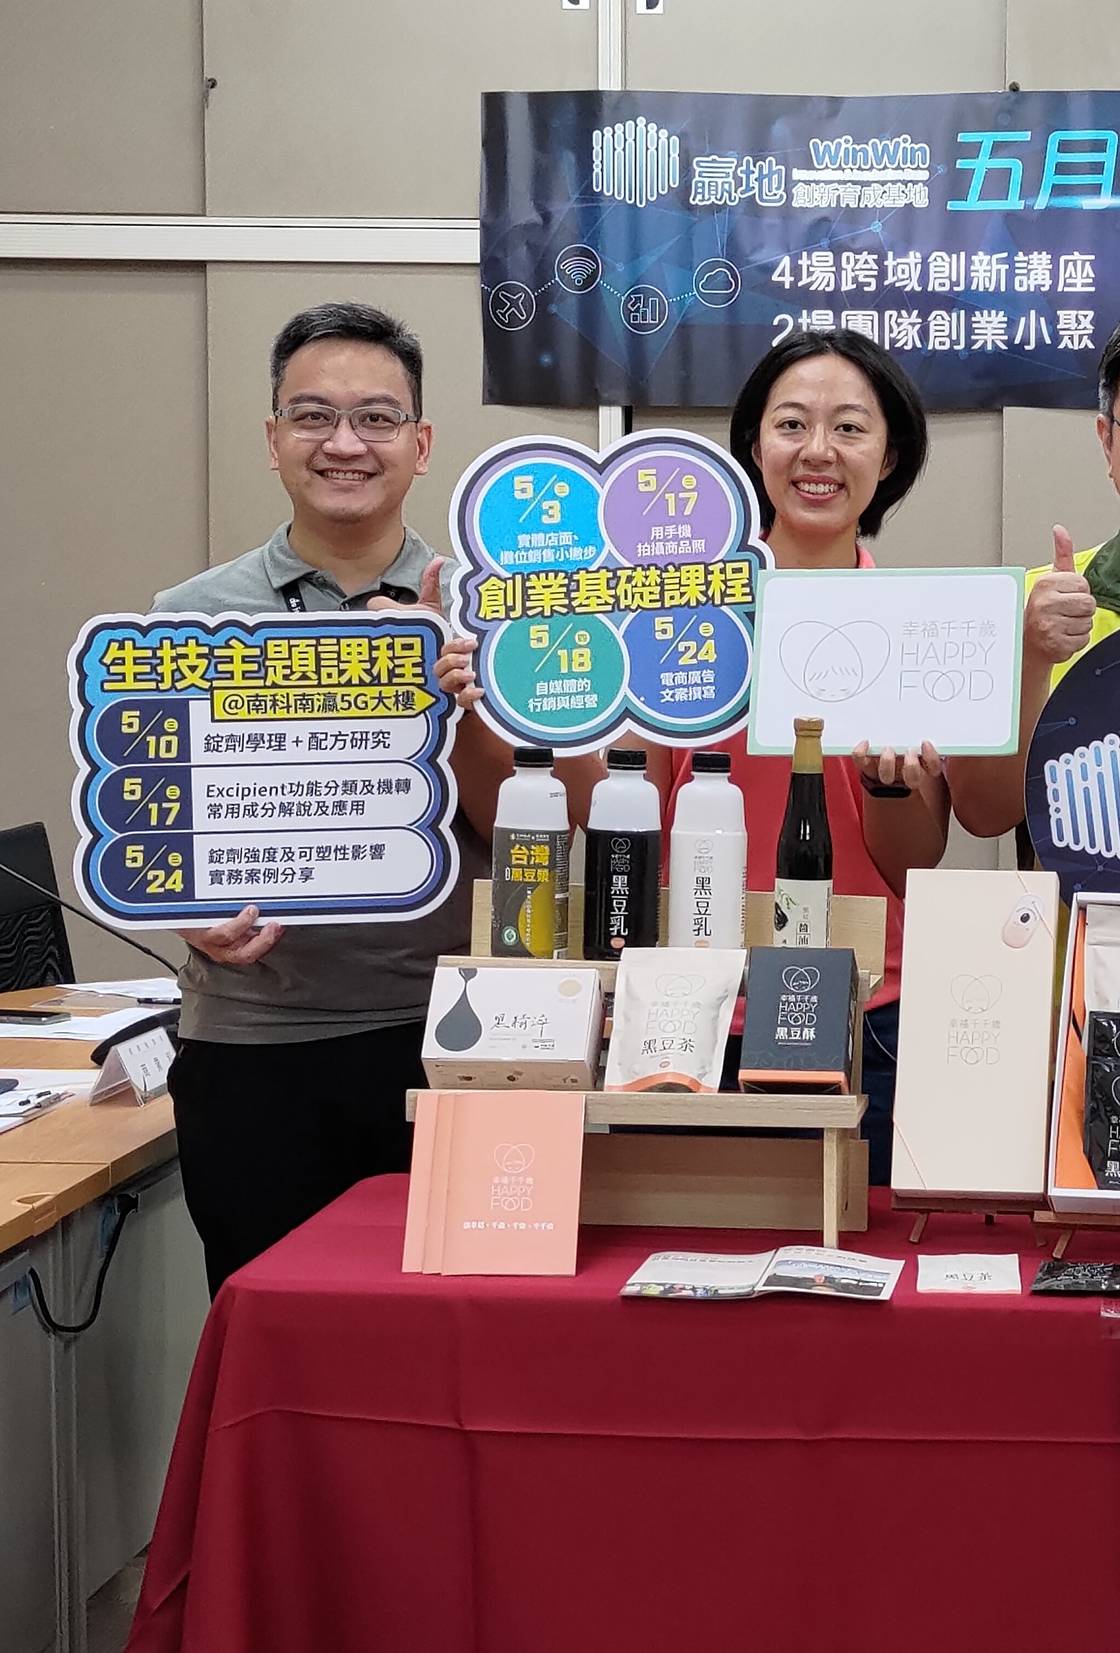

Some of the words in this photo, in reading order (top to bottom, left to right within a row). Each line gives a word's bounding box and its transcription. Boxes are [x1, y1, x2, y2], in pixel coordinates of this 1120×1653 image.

[809, 135, 930, 169] WinWin
[690, 156, 787, 207] 贏地
[792, 183, 929, 208] 創新育成基地
[771, 250, 1096, 293] 4場跨域創新講座
[637, 466, 698, 517] 5/17
[650, 523, 692, 541] 用手機
[636, 540, 706, 558] 拍攝商品照
[478, 560, 753, 621] 創業基礎課程
[654, 614, 718, 666] 5/24
[901, 620, 998, 639] 幸福千千歲
[529, 623, 593, 674] 5/18
[899, 640, 997, 666] HAPPY
[101, 635, 426, 691] 生技主題課程
[536, 677, 591, 696] 自媒體的
[660, 669, 716, 686] 電商廣告
[898, 669, 995, 703] FOOD
[527, 693, 598, 713] 行銷與經營
[659, 685, 716, 703] 文案撰寫
[120, 709, 180, 759] 5/10
[205, 778, 412, 799] Excipient功能分類及機轉
[122, 776, 182, 827] 5/17
[206, 799, 366, 821] 常用成分解說及應用
[207, 843, 387, 865] 錠劑強度及可塑性影響
[510, 844, 551, 866] 台灣
[124, 844, 184, 894] 5/24
[208, 866, 316, 886] 實務案例分享
[608, 874, 630, 937] 黑豆乳
[691, 875, 713, 938] 黑豆乳
[648, 1008, 700, 1021] HAPPY
[779, 1003, 818, 1014] HAPPY
[775, 1027, 817, 1041] 黑豆酥
[947, 1031, 1000, 1046] HAPPY
[641, 1037, 696, 1056] 黑豆茶
[946, 1046, 1001, 1066] FOOD
[490, 1185, 534, 1197] HAPPY
